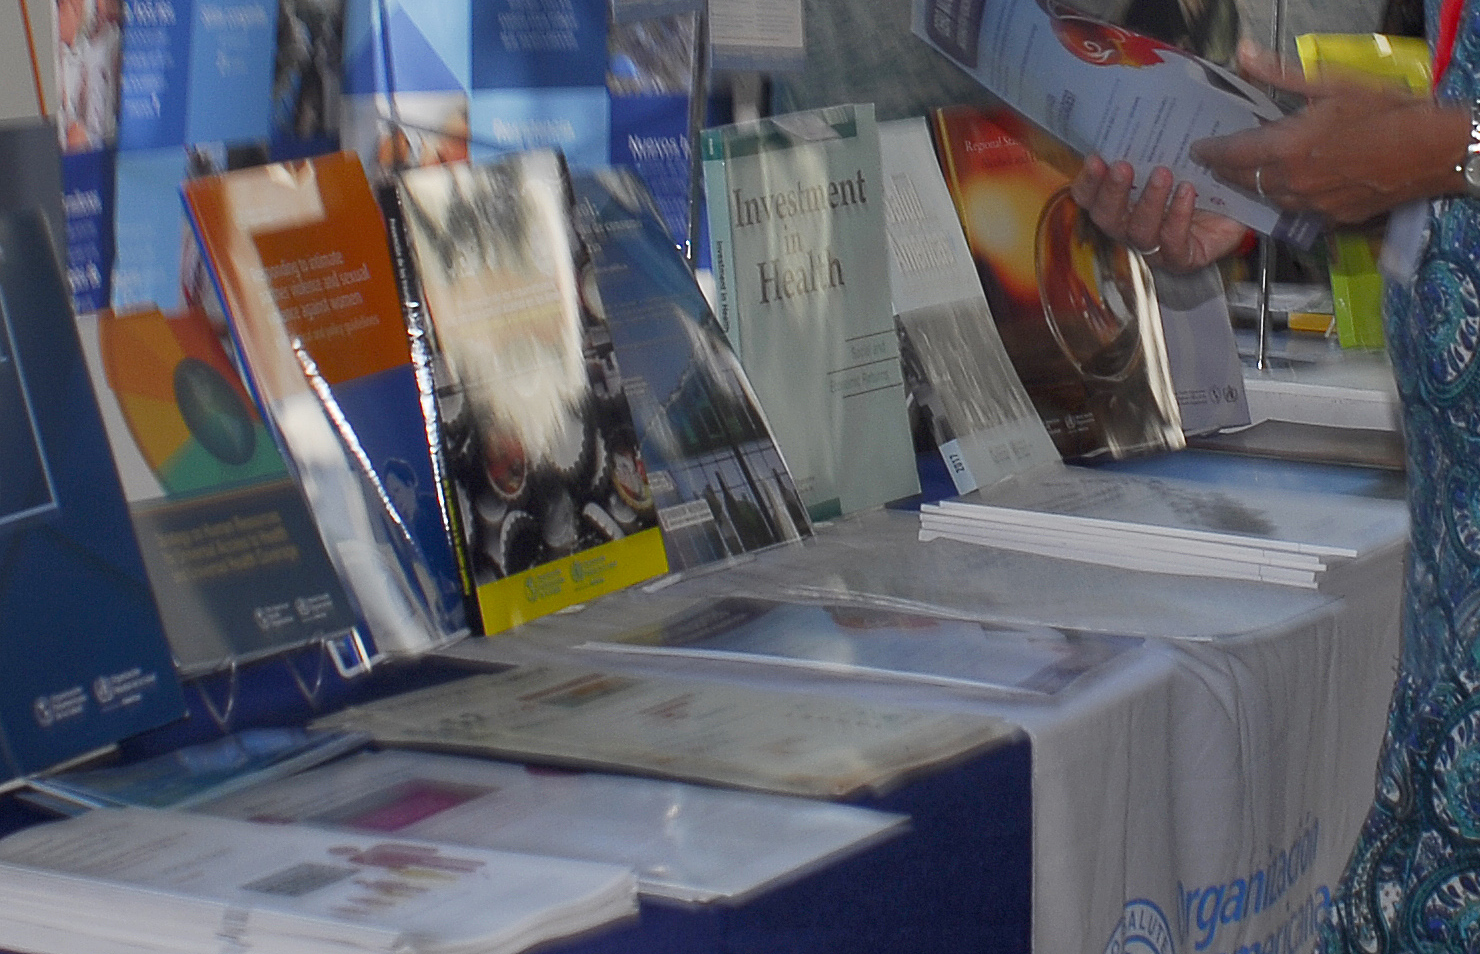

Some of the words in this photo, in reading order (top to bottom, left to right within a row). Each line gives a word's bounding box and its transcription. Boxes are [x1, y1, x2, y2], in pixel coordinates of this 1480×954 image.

[732, 169, 867, 229] Investment
[784, 224, 801, 254] in
[757, 249, 845, 305] Health
